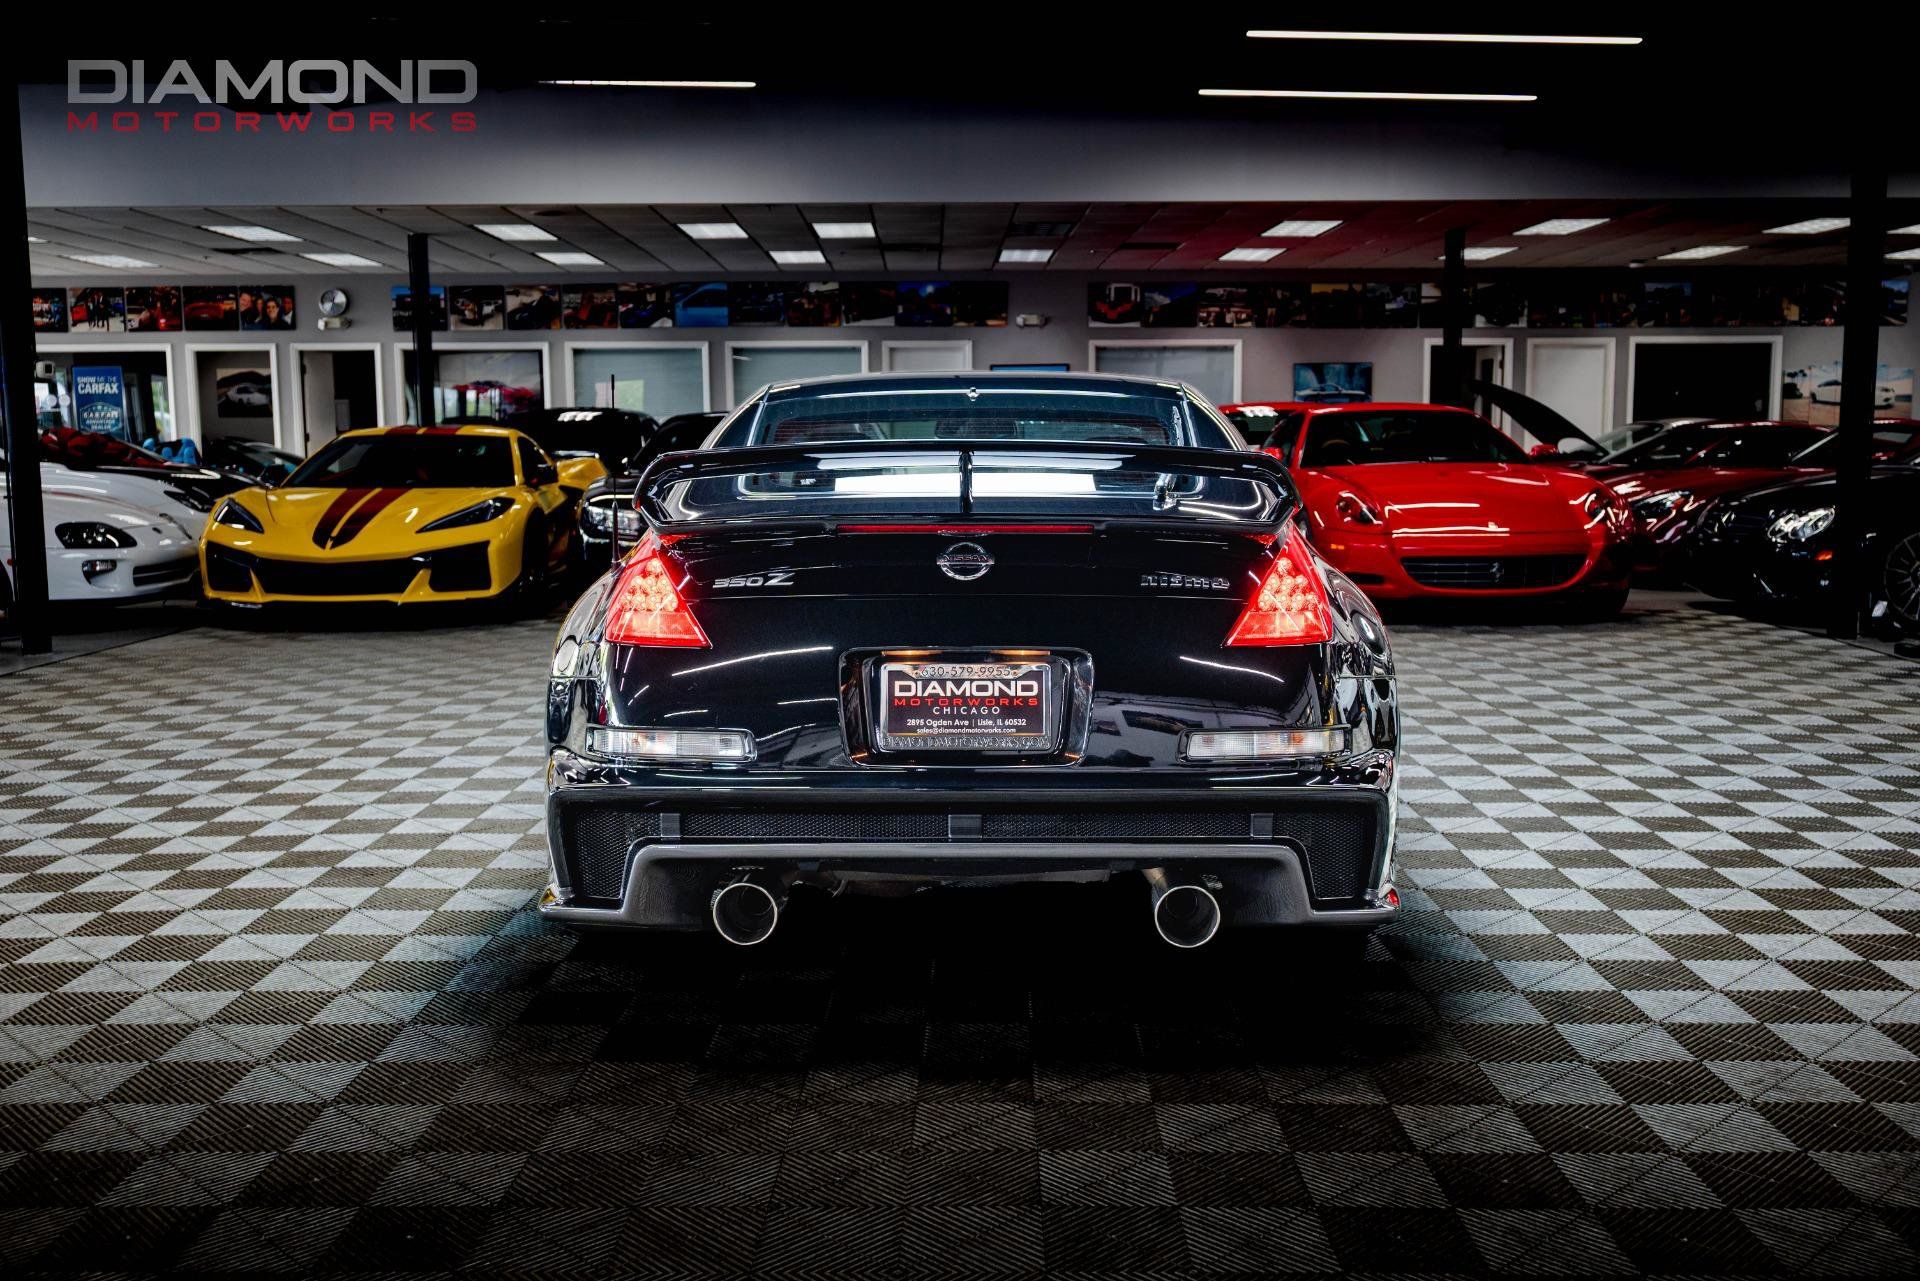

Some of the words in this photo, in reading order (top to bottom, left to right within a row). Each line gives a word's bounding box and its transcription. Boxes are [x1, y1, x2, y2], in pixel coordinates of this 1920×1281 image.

[78, 383, 119, 394] CARFAX
[941, 554, 988, 562] NISSAN
[712, 572, 796, 589] 350Z
[921, 666, 1011, 677] 630-579-9955
[894, 680, 1039, 697] DIAMOND
[894, 698, 1038, 706] MOTORWORKS
[932, 706, 1001, 715] CHICAGO
[906, 718, 925, 726] 2895
[925, 718, 953, 728] Ogden
[953, 718, 970, 726] Ave
[977, 718, 995, 727] Lisle,
[996, 718, 1003, 726] IL
[1004, 718, 1027, 726] 60532
[916, 726, 1017, 735] sales@diamondmotorworks.com
